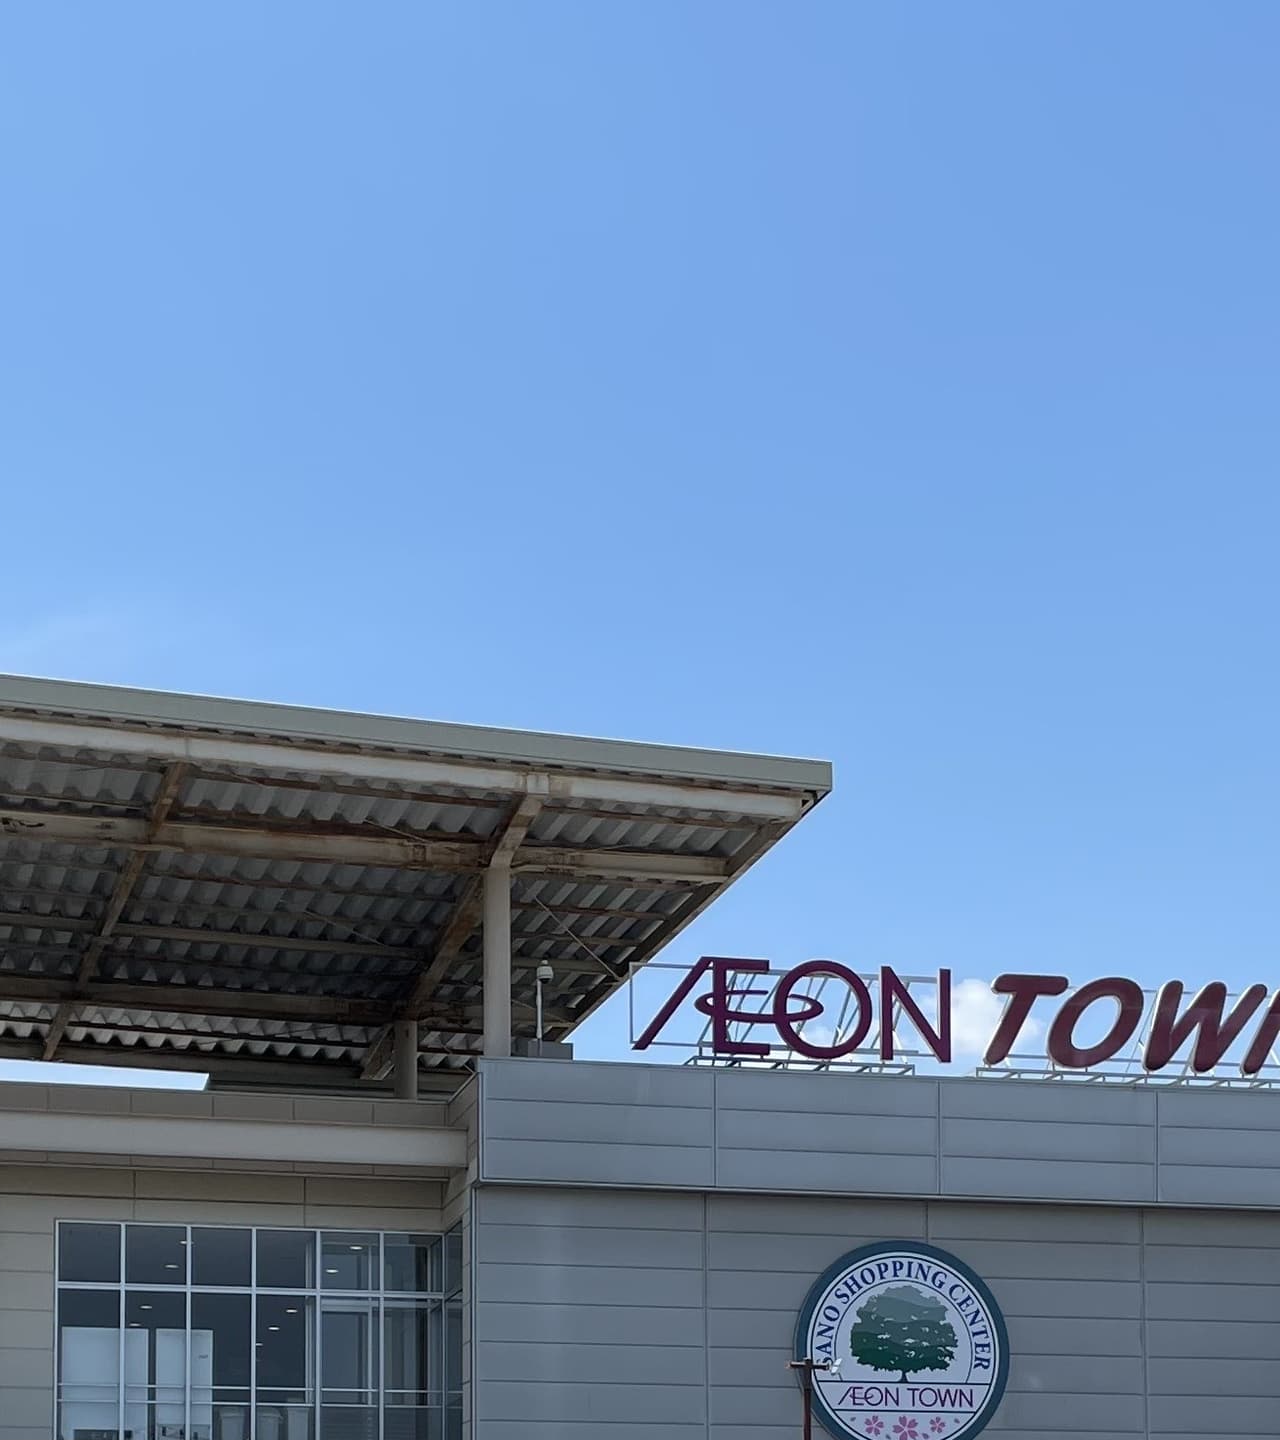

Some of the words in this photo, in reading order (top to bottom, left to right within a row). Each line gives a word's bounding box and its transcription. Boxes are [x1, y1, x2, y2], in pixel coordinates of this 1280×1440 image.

[835, 1259, 949, 1305] SHOPPING
[948, 1283, 992, 1370] CENTER
[907, 1387, 974, 1409] TOWN
